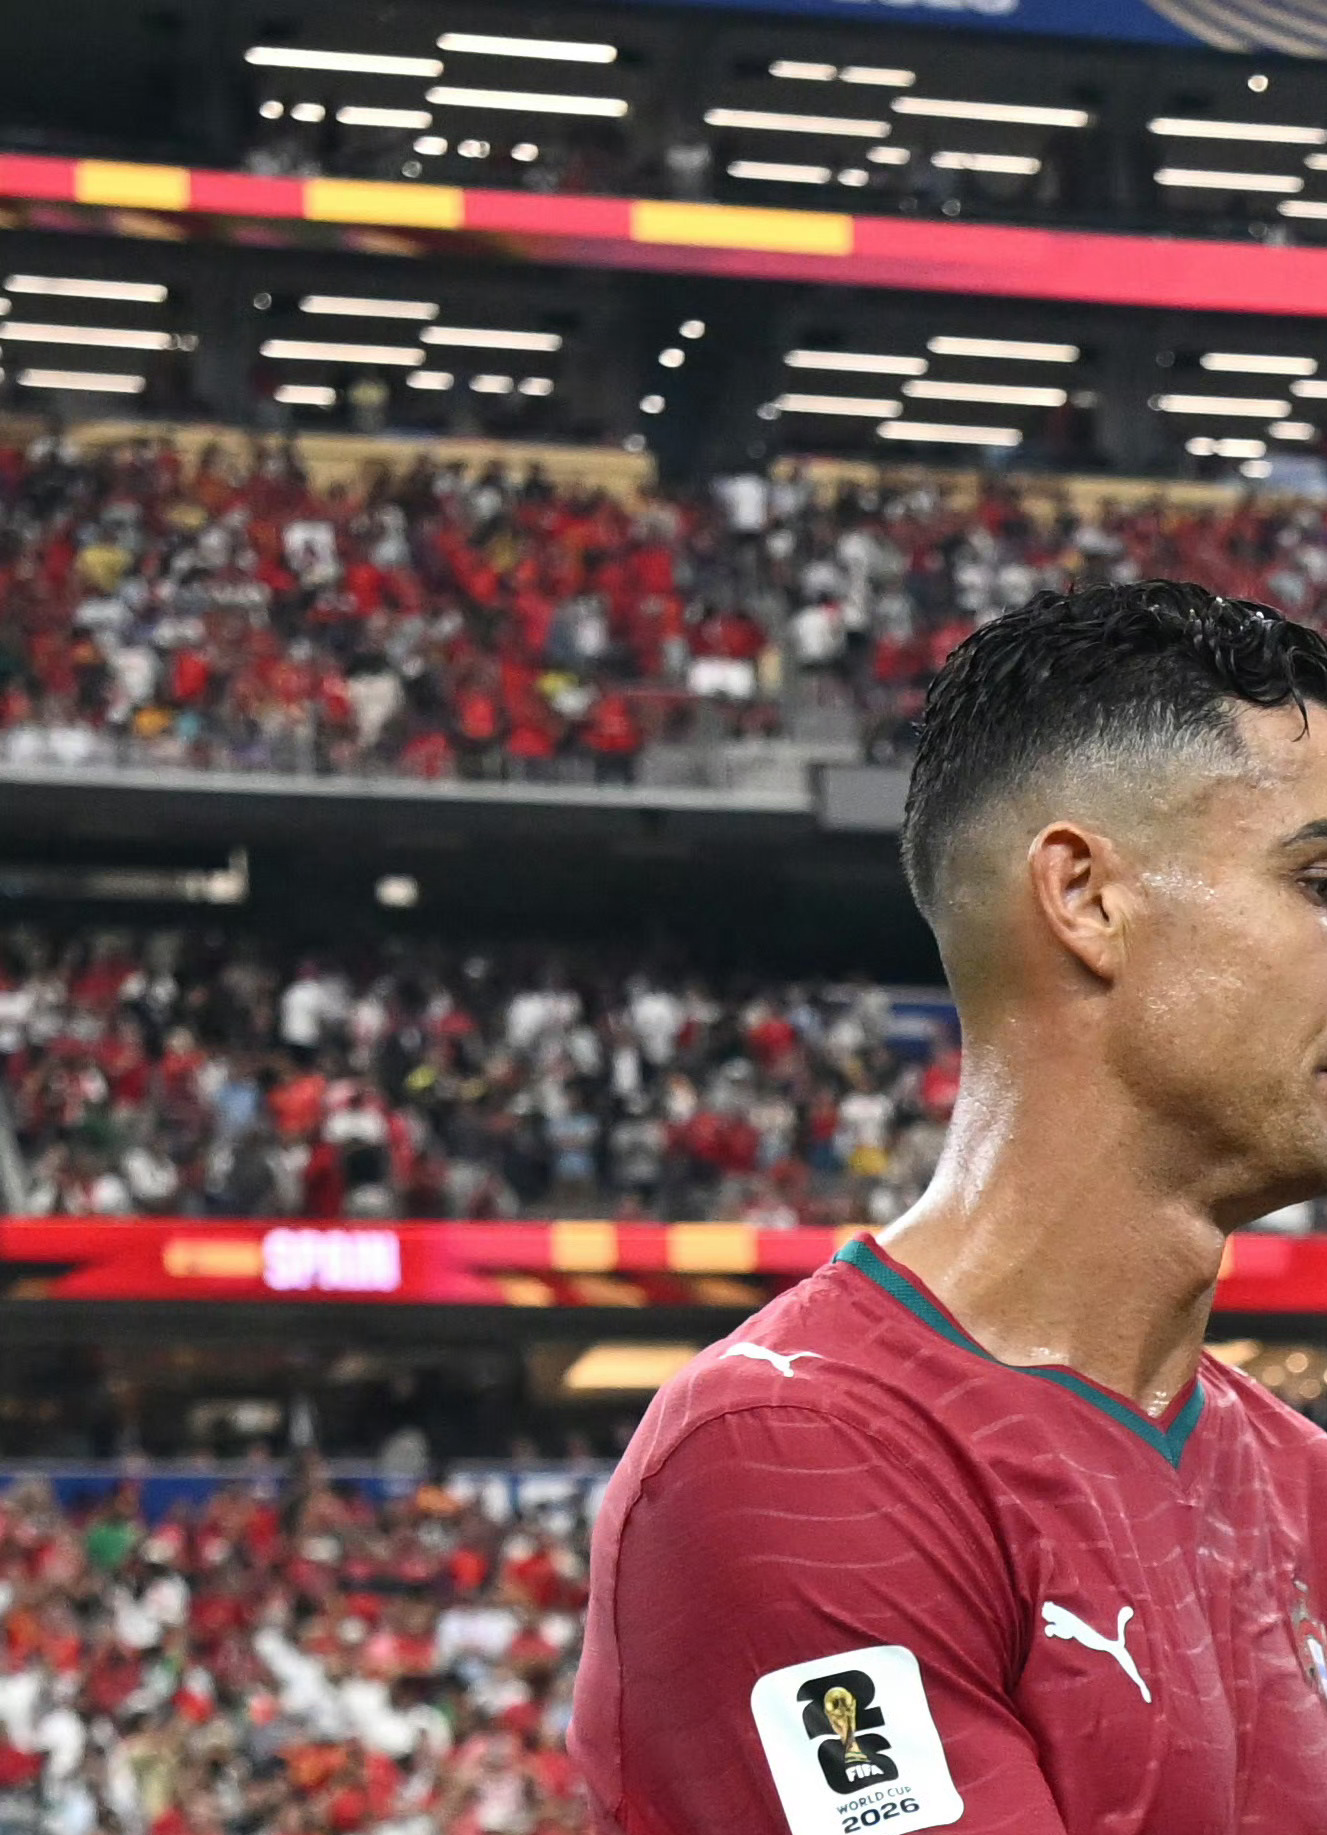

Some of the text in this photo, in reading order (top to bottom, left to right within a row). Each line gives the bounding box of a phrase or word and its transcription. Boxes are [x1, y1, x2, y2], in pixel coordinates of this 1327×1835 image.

[845, 1763, 884, 1782] FIFA
[836, 1786, 912, 1815] WORLD CUP
[841, 1797, 920, 1834] 2026
